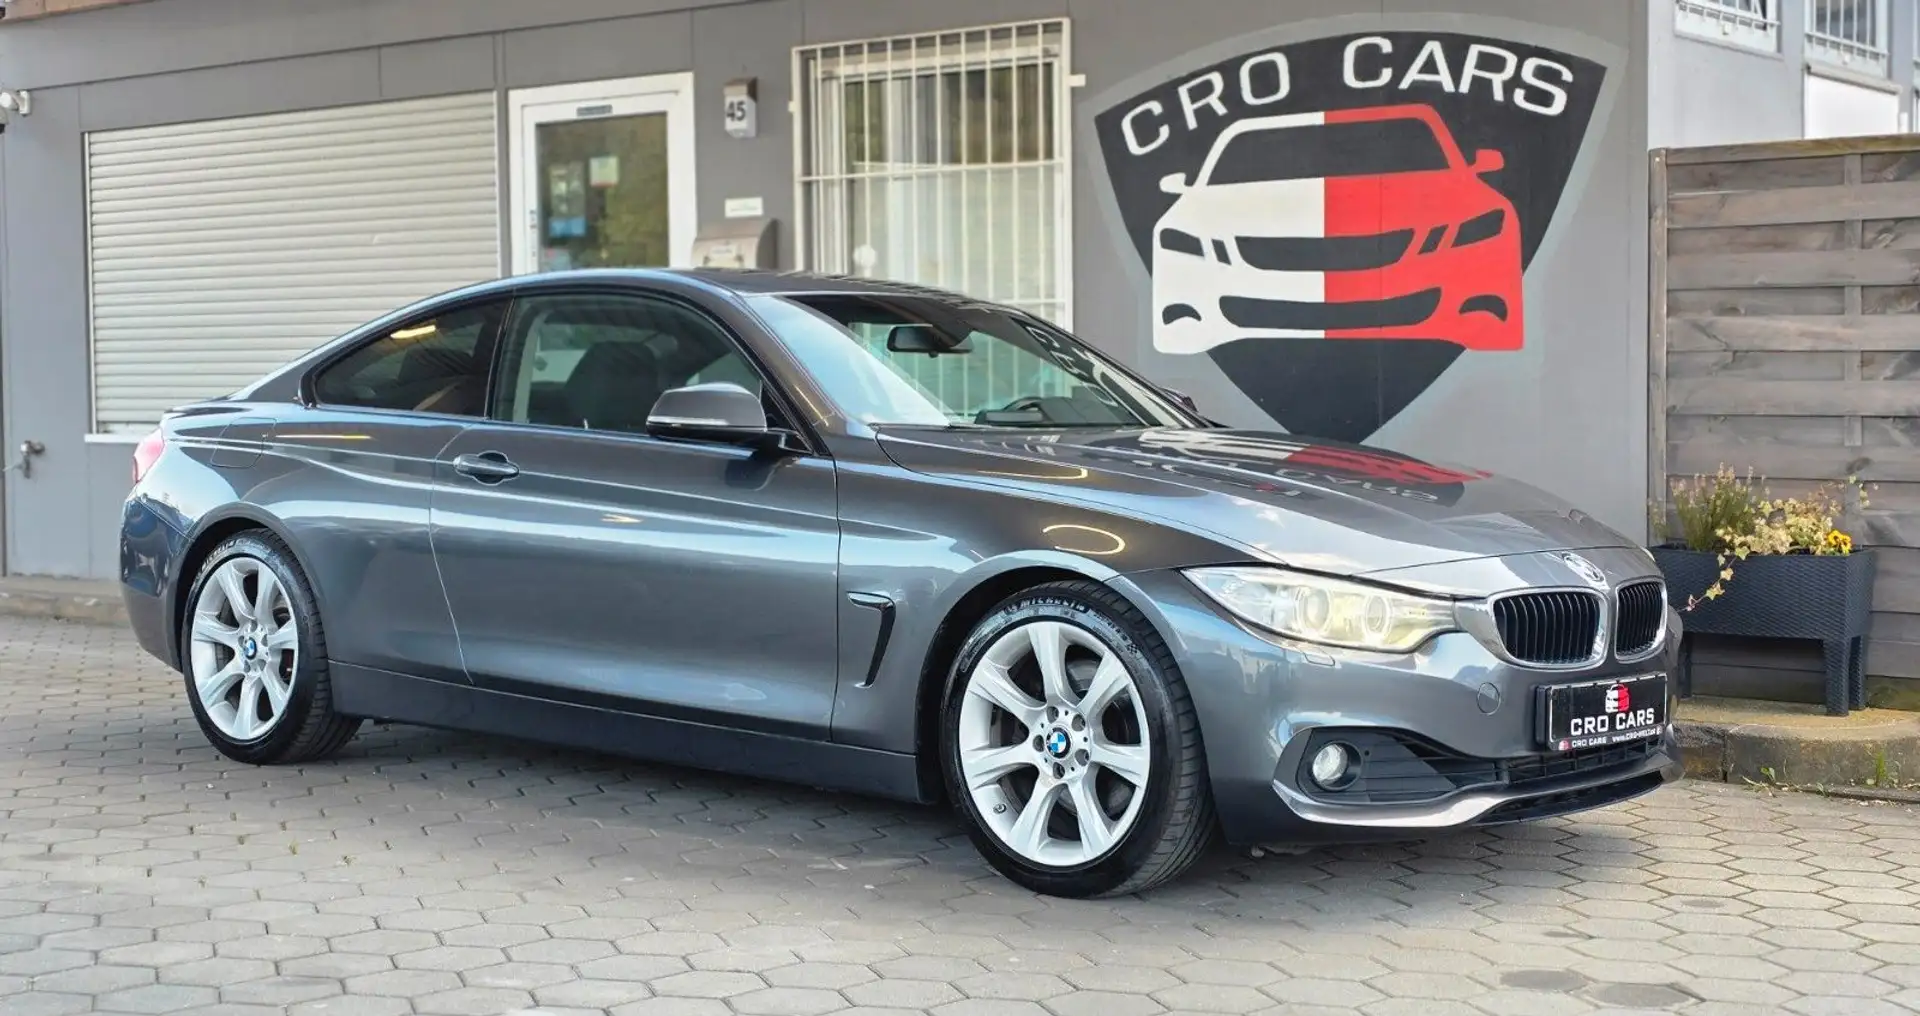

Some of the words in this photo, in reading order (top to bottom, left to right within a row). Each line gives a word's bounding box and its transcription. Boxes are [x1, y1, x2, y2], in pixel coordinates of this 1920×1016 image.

[1120, 51, 1290, 157] CRO
[1342, 36, 1575, 117] CARS
[726, 101, 747, 122] 45
[1570, 715, 1609, 737] CRO
[1615, 708, 1655, 731] CARS
[1571, 739, 1588, 749] CRO
[1588, 736, 1607, 747] CARS
